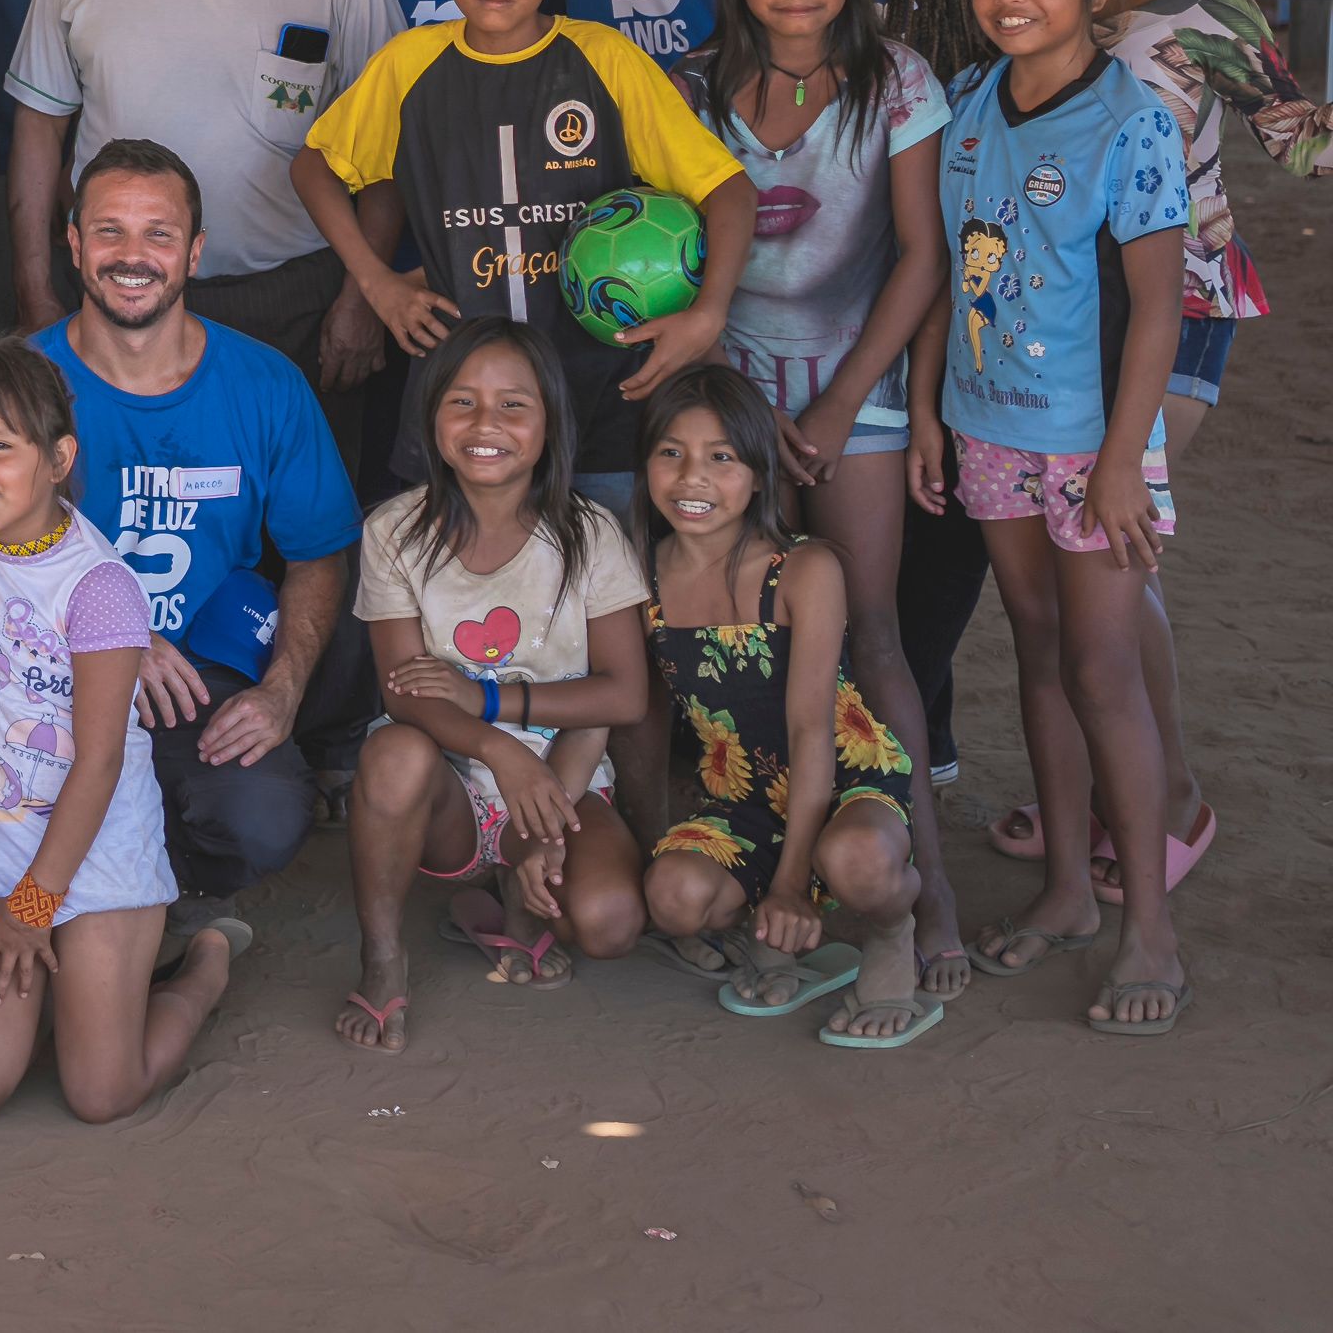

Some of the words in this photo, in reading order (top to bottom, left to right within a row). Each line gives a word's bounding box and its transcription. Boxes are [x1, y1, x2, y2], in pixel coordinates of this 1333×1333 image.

[545, 161, 563, 170] AD.
[564, 157, 596, 169] MISSÃO
[443, 206, 505, 228] ESUS
[472, 246, 559, 288] Graça
[184, 479, 223, 491] MARCOS
[119, 498, 148, 529] DE
[152, 501, 198, 531] LUZ
[243, 605, 266, 624] LITRO
